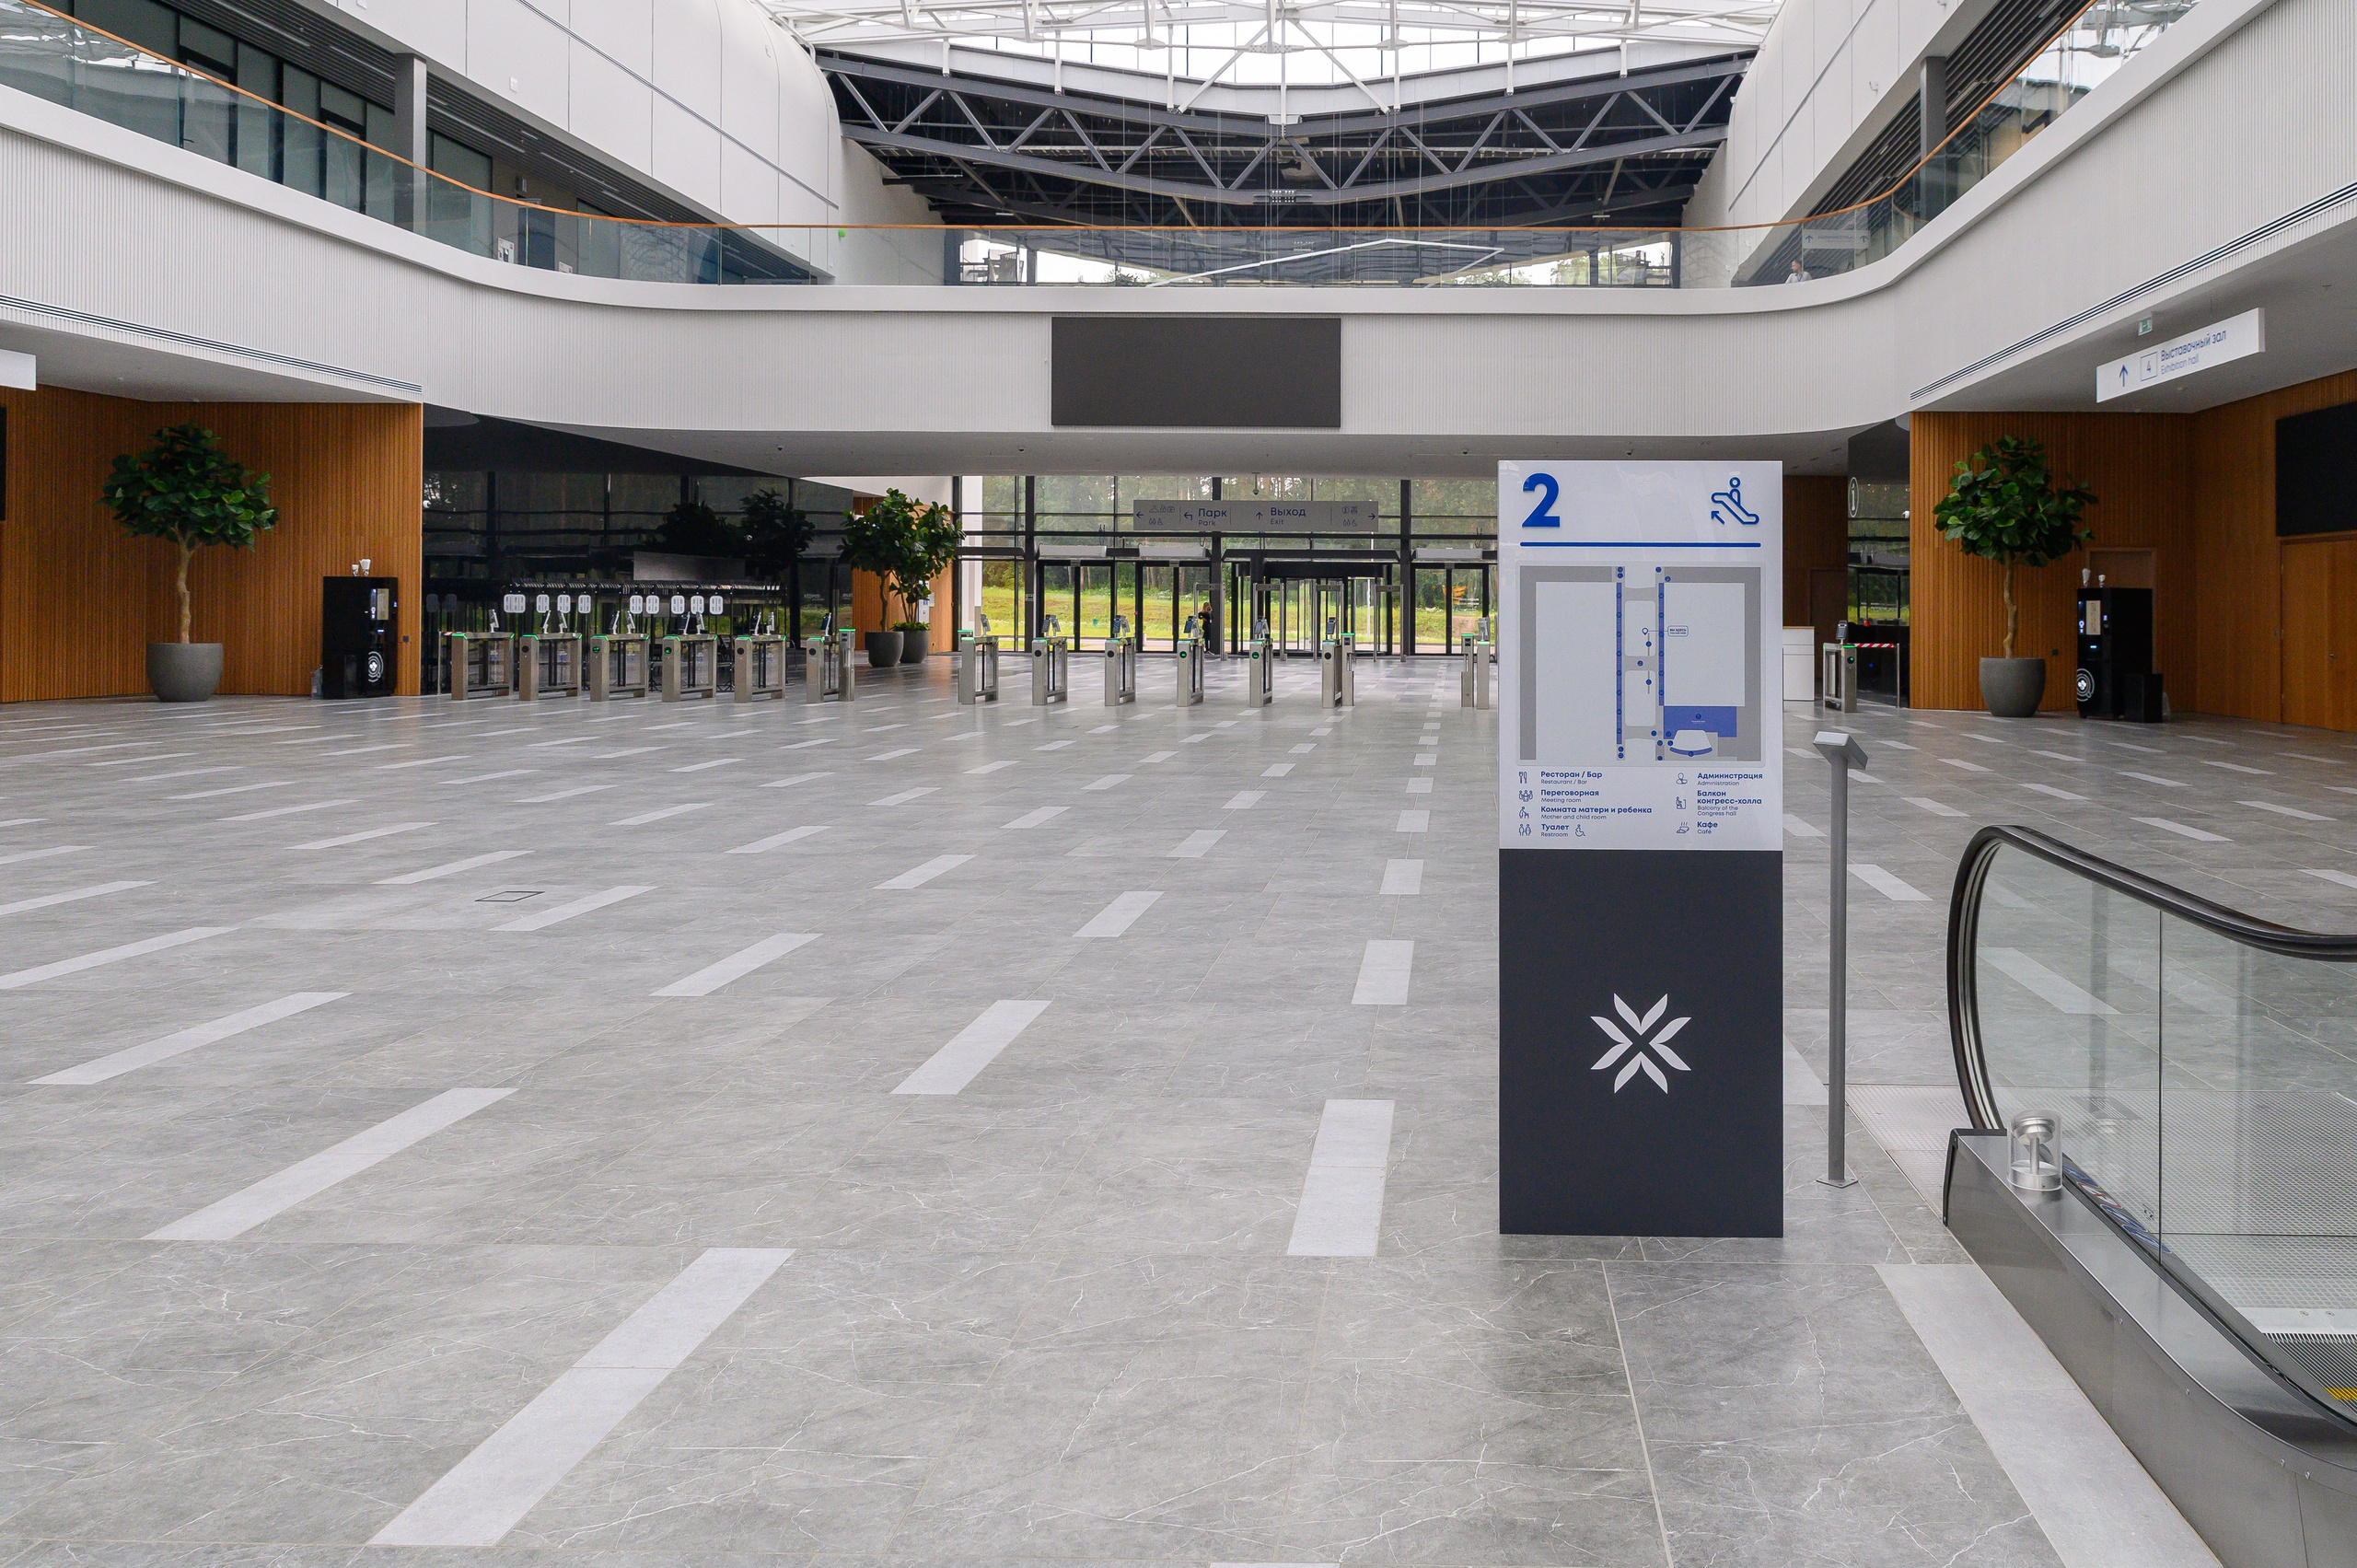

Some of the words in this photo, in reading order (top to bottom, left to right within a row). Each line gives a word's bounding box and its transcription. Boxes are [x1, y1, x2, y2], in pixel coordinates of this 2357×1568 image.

[2161, 333, 2210, 361] Выставочный
[2212, 331, 2227, 343] зал
[2146, 360, 2152, 373] 4
[2161, 360, 2188, 375] Exhibition
[2188, 354, 2200, 366] hall
[1522, 473, 1560, 528] 2
[1199, 507, 1228, 518] Парк
[1271, 506, 1306, 517] Выход
[1541, 771, 1579, 779] Ресторан
[1587, 771, 1603, 779] Бар
[1541, 789, 1599, 797] Переговорная
